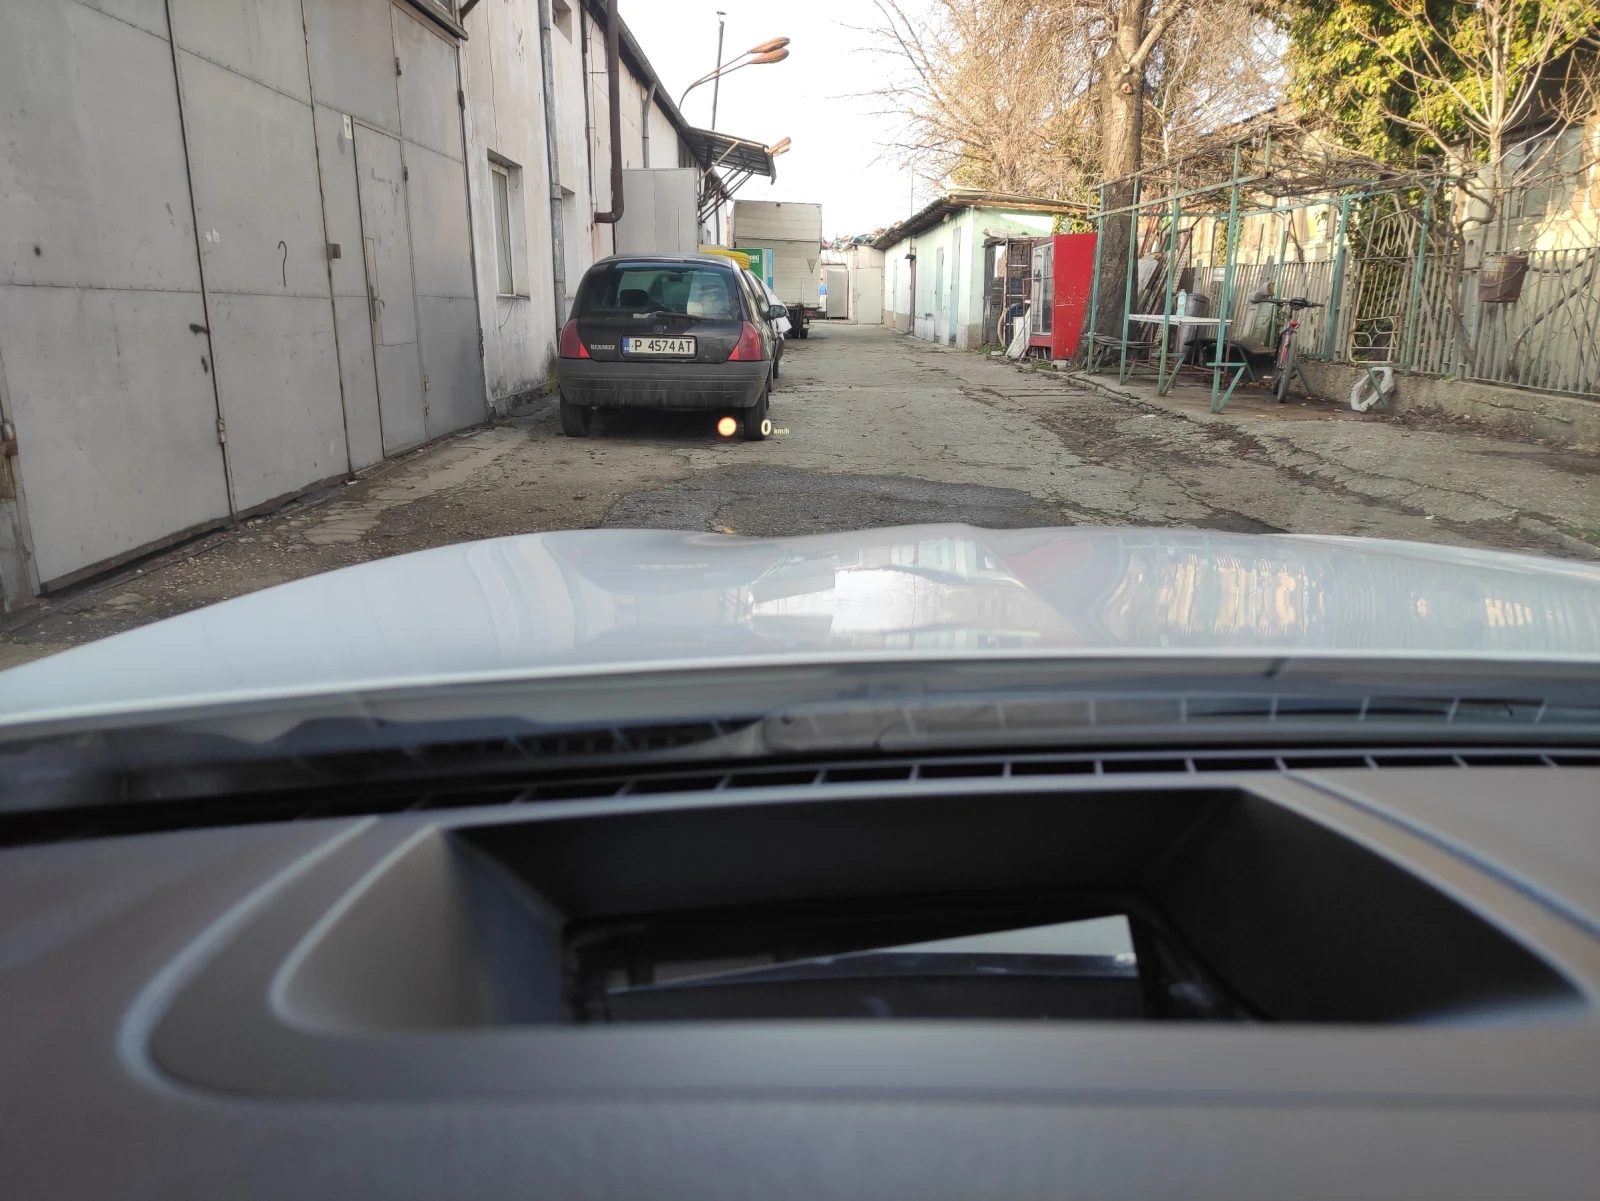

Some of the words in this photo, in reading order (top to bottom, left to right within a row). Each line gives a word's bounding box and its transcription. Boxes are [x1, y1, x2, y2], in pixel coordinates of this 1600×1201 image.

[634, 339, 642, 351] P
[648, 340, 675, 352] 4574
[678, 341, 692, 352] AT
[761, 419, 772, 436] 0
[773, 427, 790, 435] km/h
